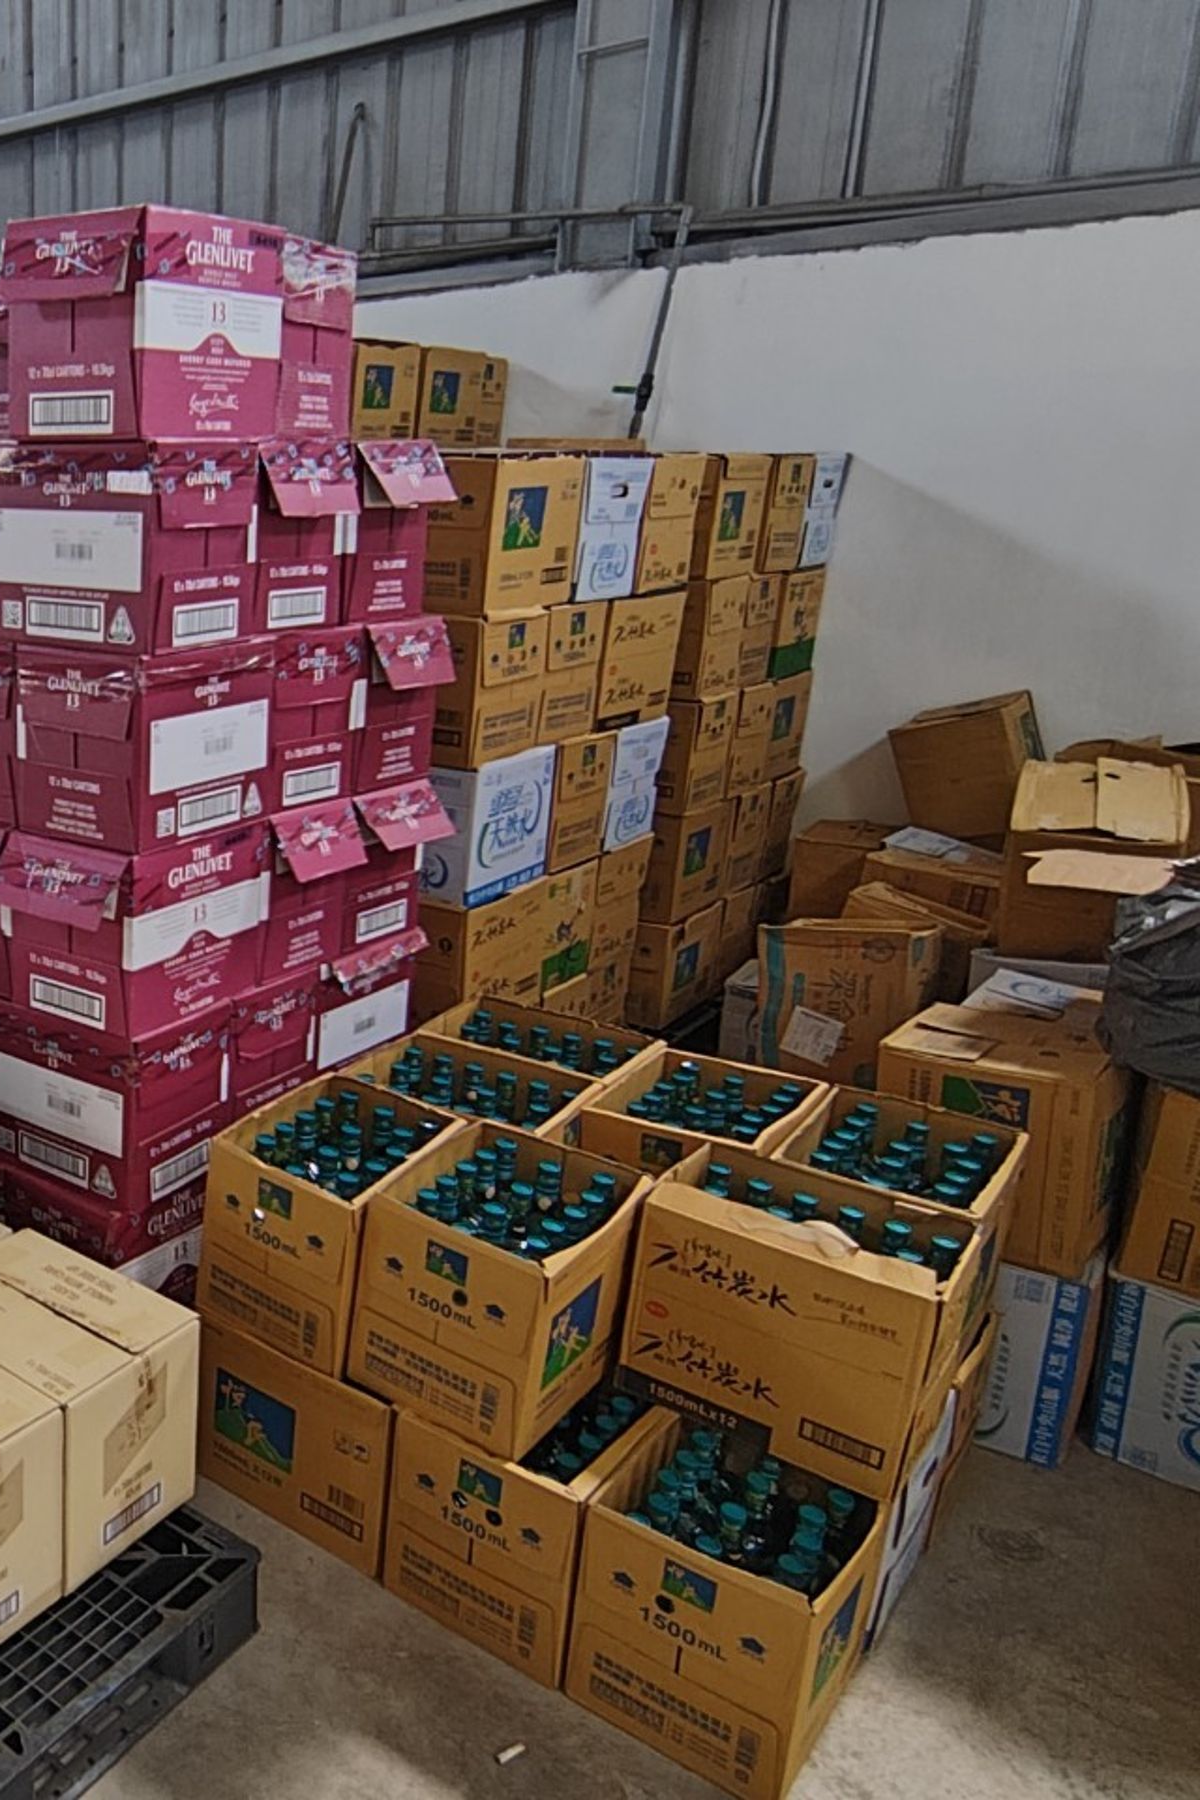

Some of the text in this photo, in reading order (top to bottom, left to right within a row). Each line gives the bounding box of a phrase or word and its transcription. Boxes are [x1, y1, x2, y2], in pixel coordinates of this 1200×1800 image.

[212, 226, 234, 246] THE
[185, 240, 256, 274] GLENLIVET
[211, 300, 227, 324] 13
[66, 693, 80, 708] 13
[191, 844, 212, 860] THE
[167, 851, 234, 889] GLENLIVET
[147, 1193, 206, 1237] GLENLIVE
[639, 1605, 728, 1663] 1500mL
